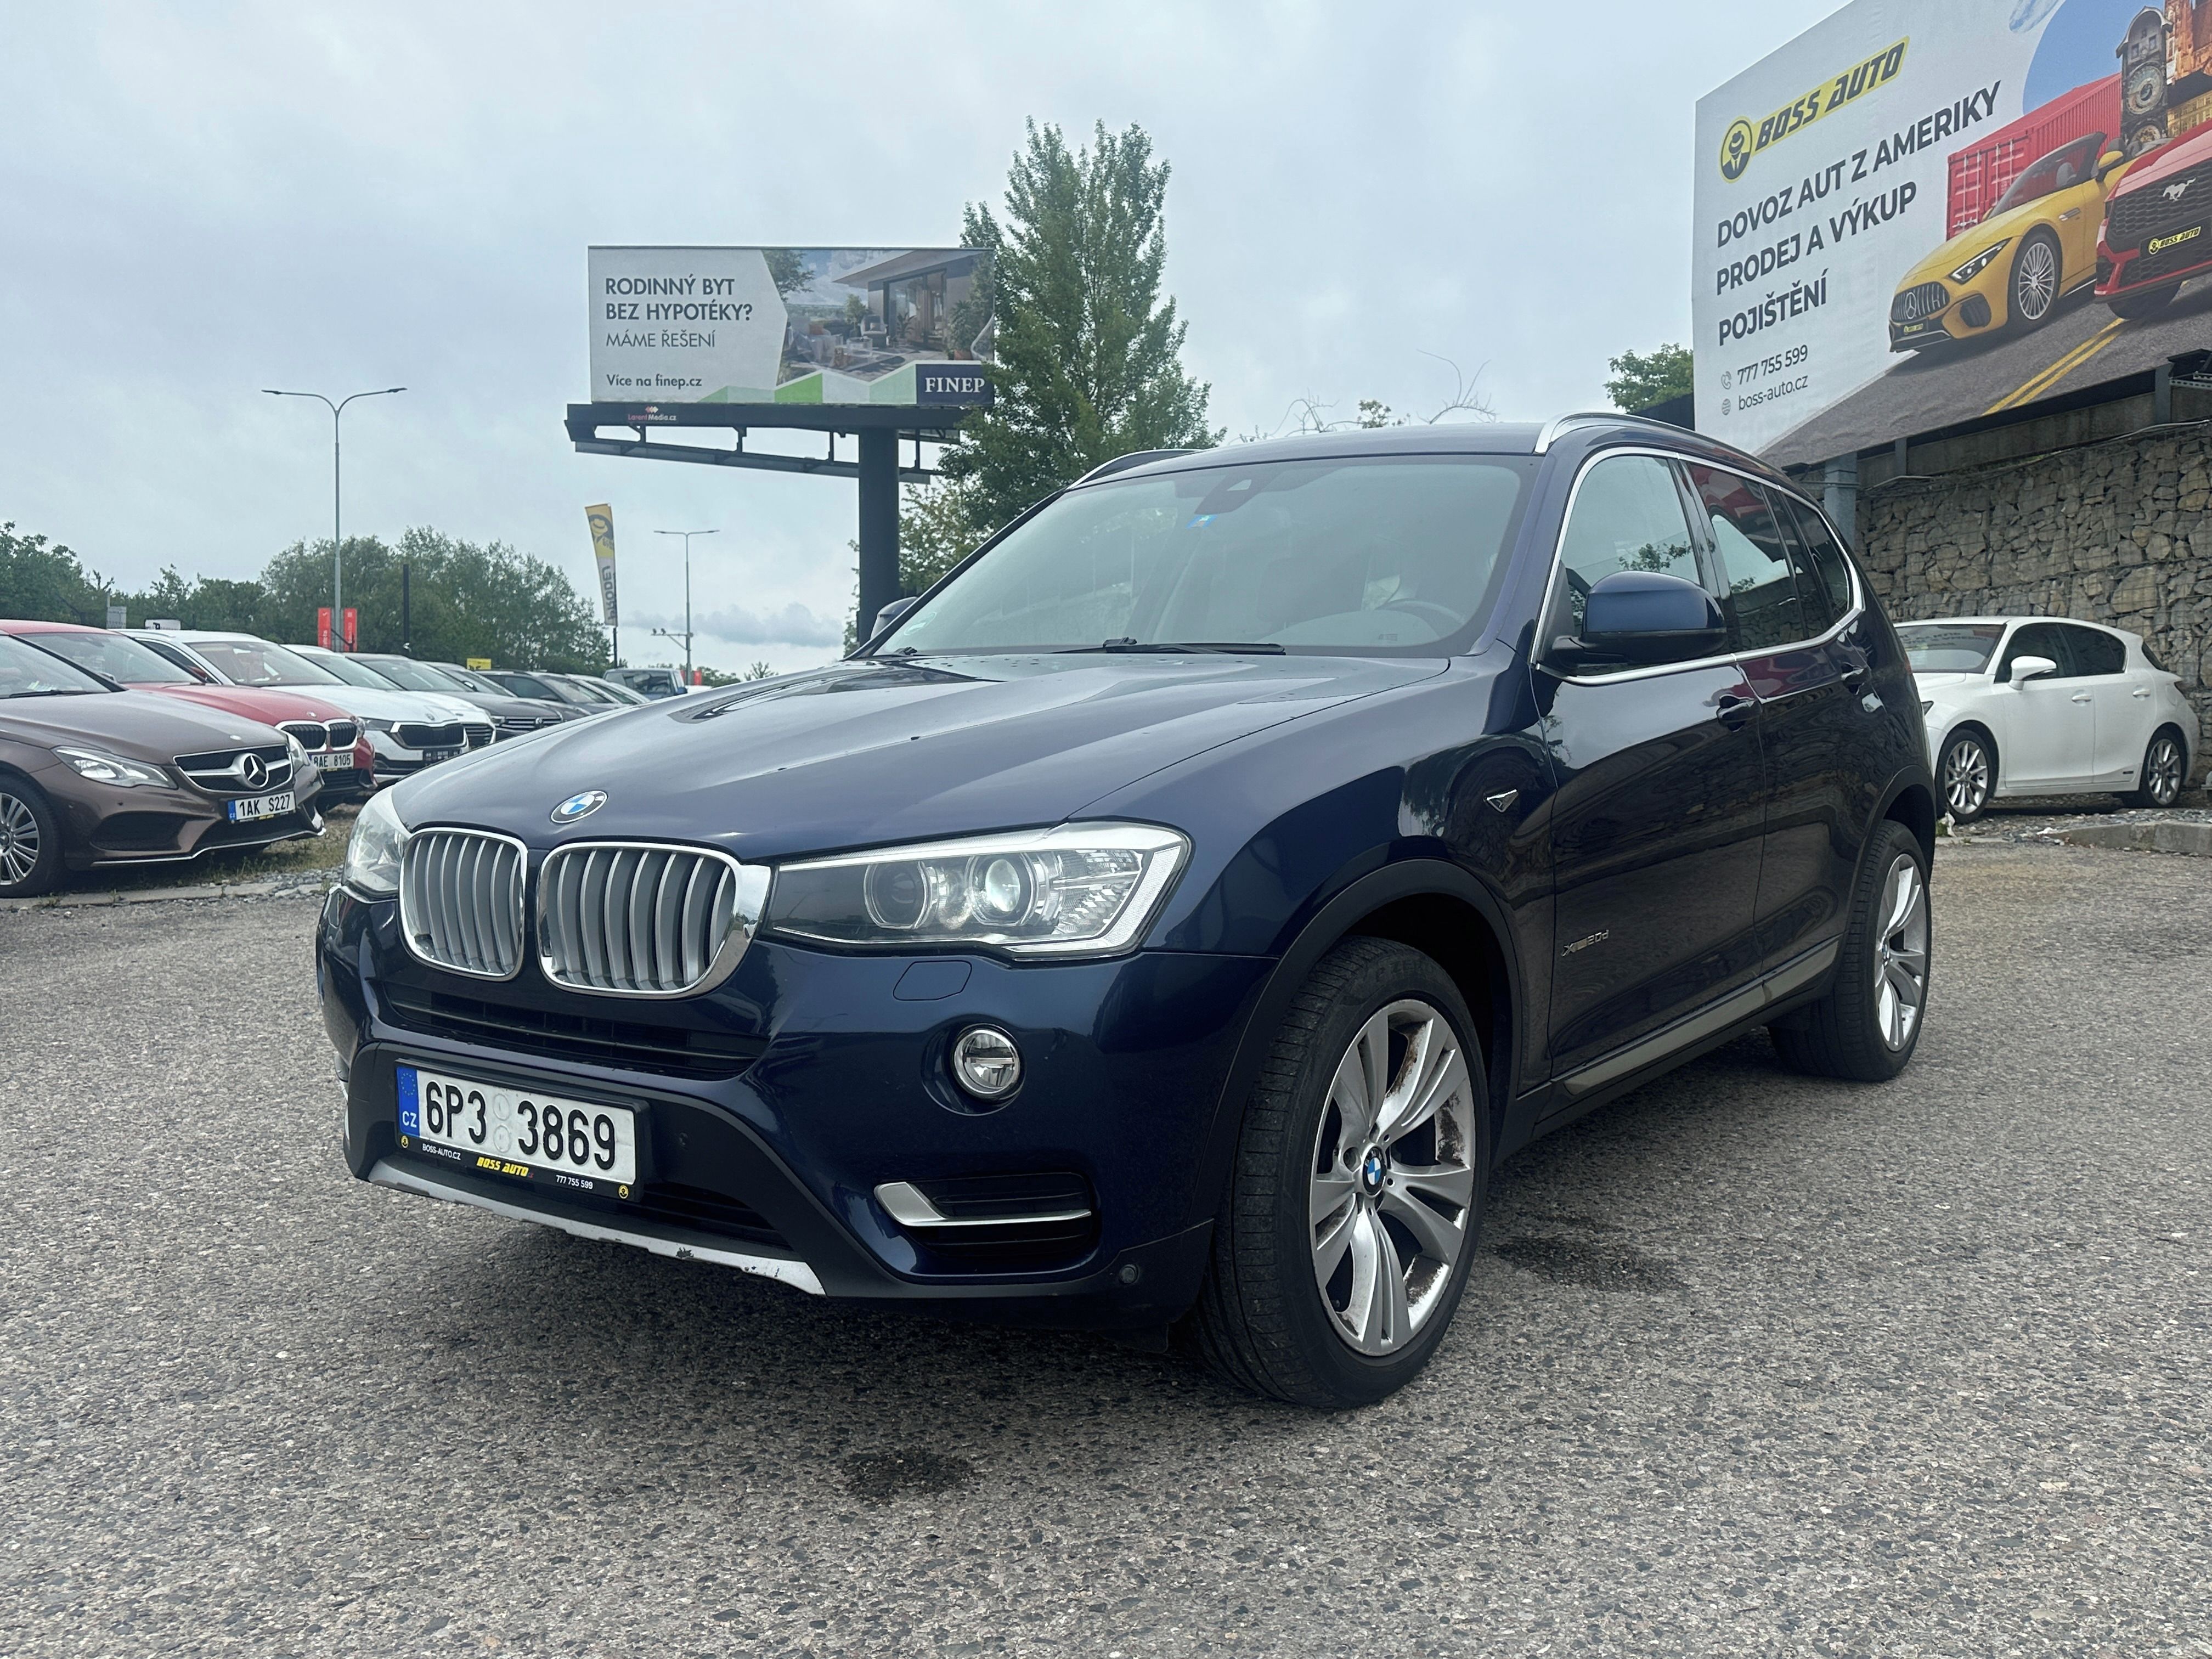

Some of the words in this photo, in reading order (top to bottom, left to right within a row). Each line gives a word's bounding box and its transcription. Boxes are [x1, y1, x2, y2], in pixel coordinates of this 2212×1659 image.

[1755, 89, 1821, 151] BOSS
[1825, 42, 1905, 113] AUTO
[1718, 186, 1793, 248] DOVOZ
[1797, 159, 1846, 209] AUT
[1851, 149, 1867, 183] Z
[1872, 80, 2001, 172] AMERIKY
[1717, 233, 1801, 295] PRODEJ
[1806, 225, 1825, 256] A
[1829, 181, 1917, 243] VÝKUP
[2160, 236, 2178, 247] BOSS
[2179, 228, 2199, 241] AUTO
[606, 274, 696, 295] RODINNÝ
[702, 278, 735, 295] BYT
[606, 303, 640, 320] BEZ
[647, 299, 753, 321] HYPOTÉKY?
[1719, 268, 1829, 346] POJIŠTĚNÍ
[606, 329, 656, 347] MÁME
[662, 329, 716, 347] ŘEŠENÍ
[1737, 363, 1759, 385] 777
[1761, 354, 1782, 376] 755
[1785, 345, 1808, 367] 599
[606, 374, 632, 386] Více
[636, 376, 651, 386] na
[656, 374, 702, 390] finep.cz
[924, 377, 985, 393] FINEP
[1739, 375, 1808, 410] boss-auto.cz
[334, 754, 351, 766] 8105
[239, 799, 260, 817] 1AK
[269, 794, 290, 812] S227
[402, 1110, 417, 1128] CZ
[426, 1081, 487, 1144] 6P3
[517, 1100, 616, 1170] 3869
[422, 1143, 461, 1160] BOSS-AUTO.CZ
[476, 1156, 501, 1171] BOSS
[501, 1163, 529, 1177] AUTO
[556, 1175, 567, 1184] 777
[567, 1177, 579, 1187] 755
[580, 1180, 593, 1189] 599
